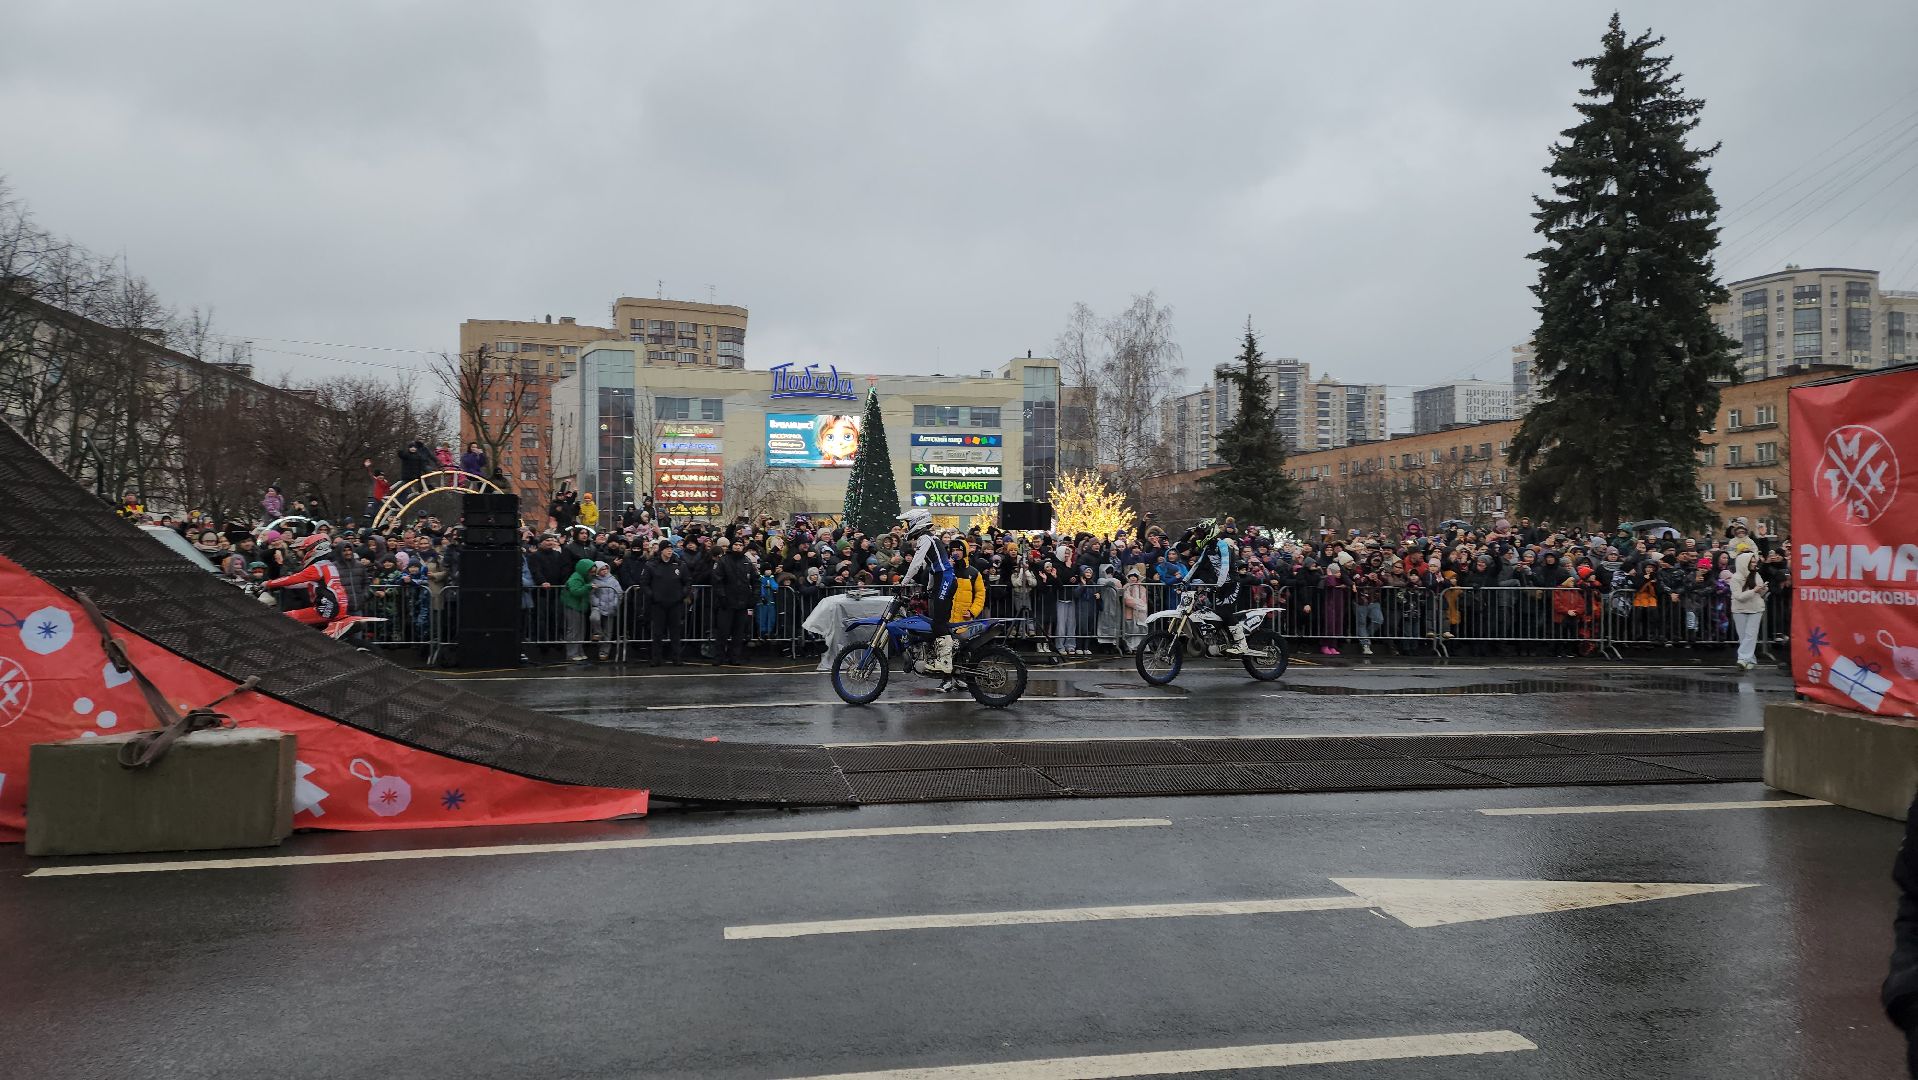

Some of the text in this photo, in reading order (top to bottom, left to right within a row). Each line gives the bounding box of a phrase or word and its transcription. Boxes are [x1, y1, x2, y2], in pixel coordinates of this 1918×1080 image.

[770, 362, 853, 394] Победа
[918, 435, 947, 443] Детский
[659, 457, 686, 466] DNS
[925, 481, 988, 490] СУПЕРМАРКЕТ
[661, 489, 717, 498] ХОЗМАКС
[930, 494, 999, 503] ЭКСТРОDENT
[1800, 544, 1918, 581] ЗИМА
[1809, 588, 1918, 606] ПОДМОСКОВЬ
